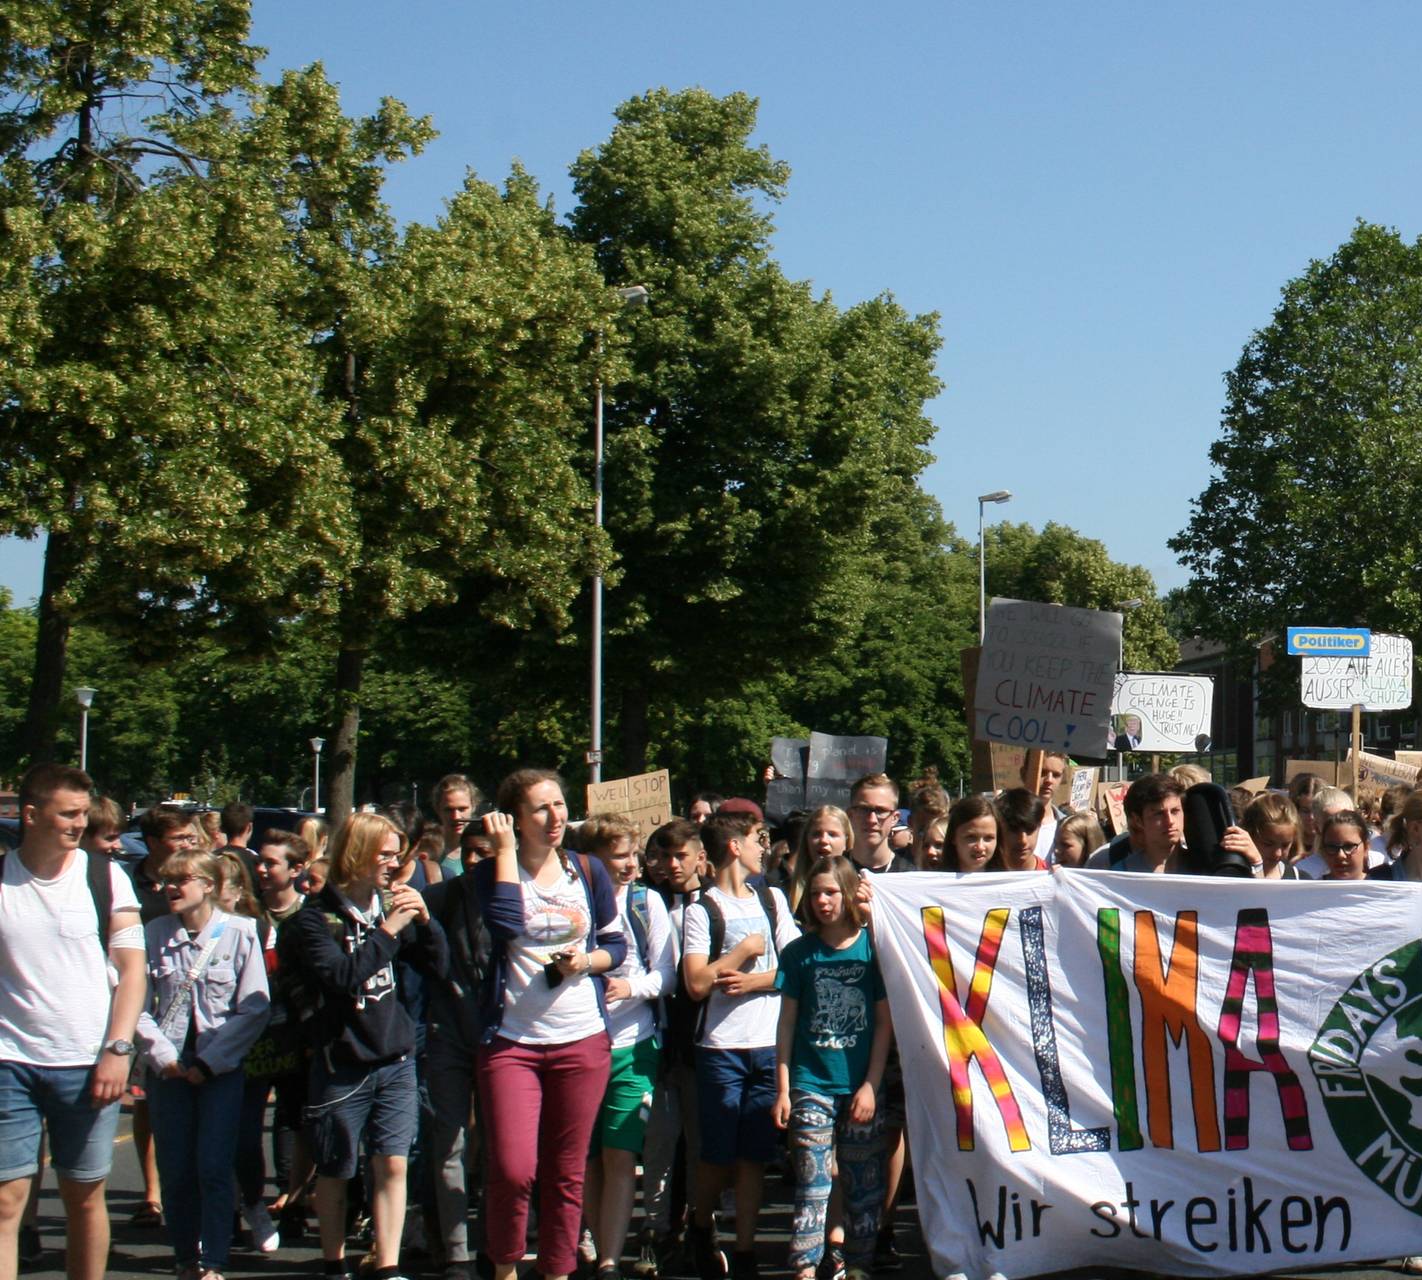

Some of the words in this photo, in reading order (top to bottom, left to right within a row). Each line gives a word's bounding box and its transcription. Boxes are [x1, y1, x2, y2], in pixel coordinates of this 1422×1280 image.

[1299, 636, 1362, 648] Politiker
[995, 679, 1096, 717] CLIMATE
[1128, 681, 1194, 699] CLIMATE
[1129, 697, 1180, 708] CHANGE
[1183, 698, 1197, 710] IS
[985, 712, 1054, 744] COOL
[1160, 721, 1184, 736] TRUST
[632, 775, 667, 798] STOP
[920, 905, 1314, 1155] KLIMA
[1310, 957, 1407, 1098] FRIDAYS
[965, 1177, 1053, 1250] Wir
[1090, 1176, 1352, 1253] streiken
